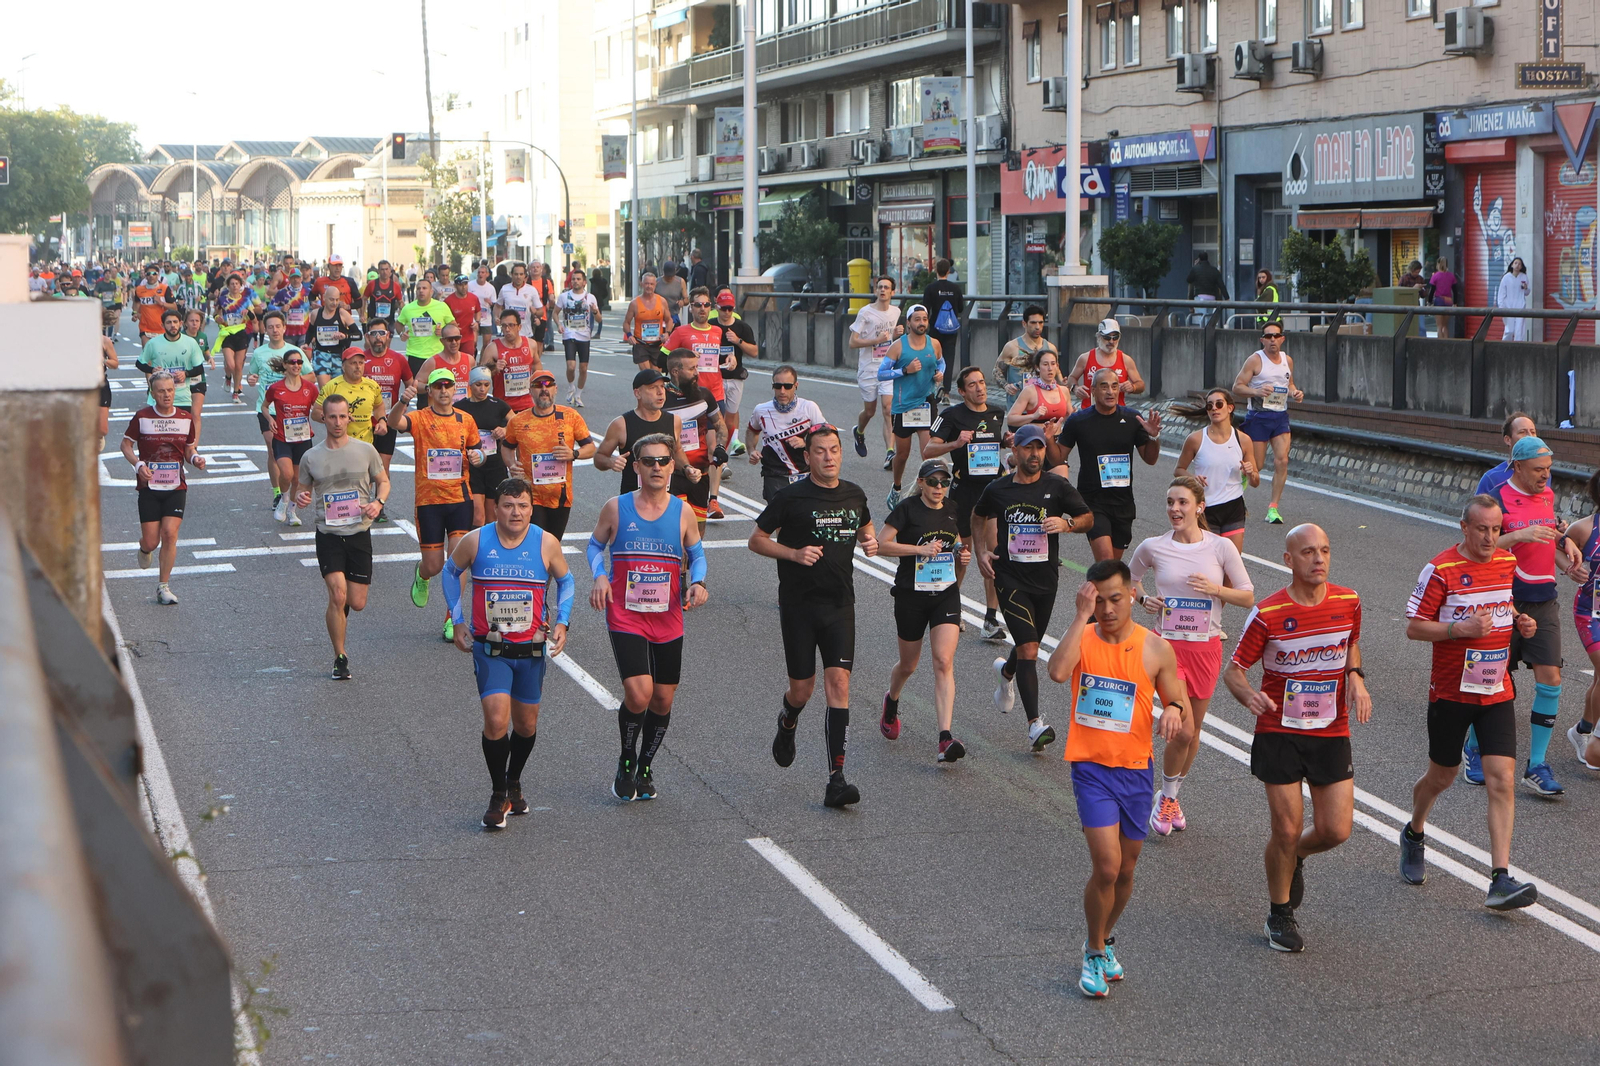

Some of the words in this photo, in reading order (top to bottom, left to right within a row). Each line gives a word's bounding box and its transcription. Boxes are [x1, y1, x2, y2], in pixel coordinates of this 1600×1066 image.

[1525, 70, 1579, 81] HOSTAL
[1468, 112, 1504, 133] JIMENEZ
[1507, 106, 1536, 129] MAÑA
[1124, 142, 1157, 160] AUTOCLIMA
[1180, 139, 1190, 154] S.L.
[625, 542, 674, 553] CREDUS
[483, 568, 534, 578] CREDUS
[1098, 681, 1128, 692] ZURICH
[1095, 698, 1113, 707] 6009
[1094, 709, 1112, 717] MARK
